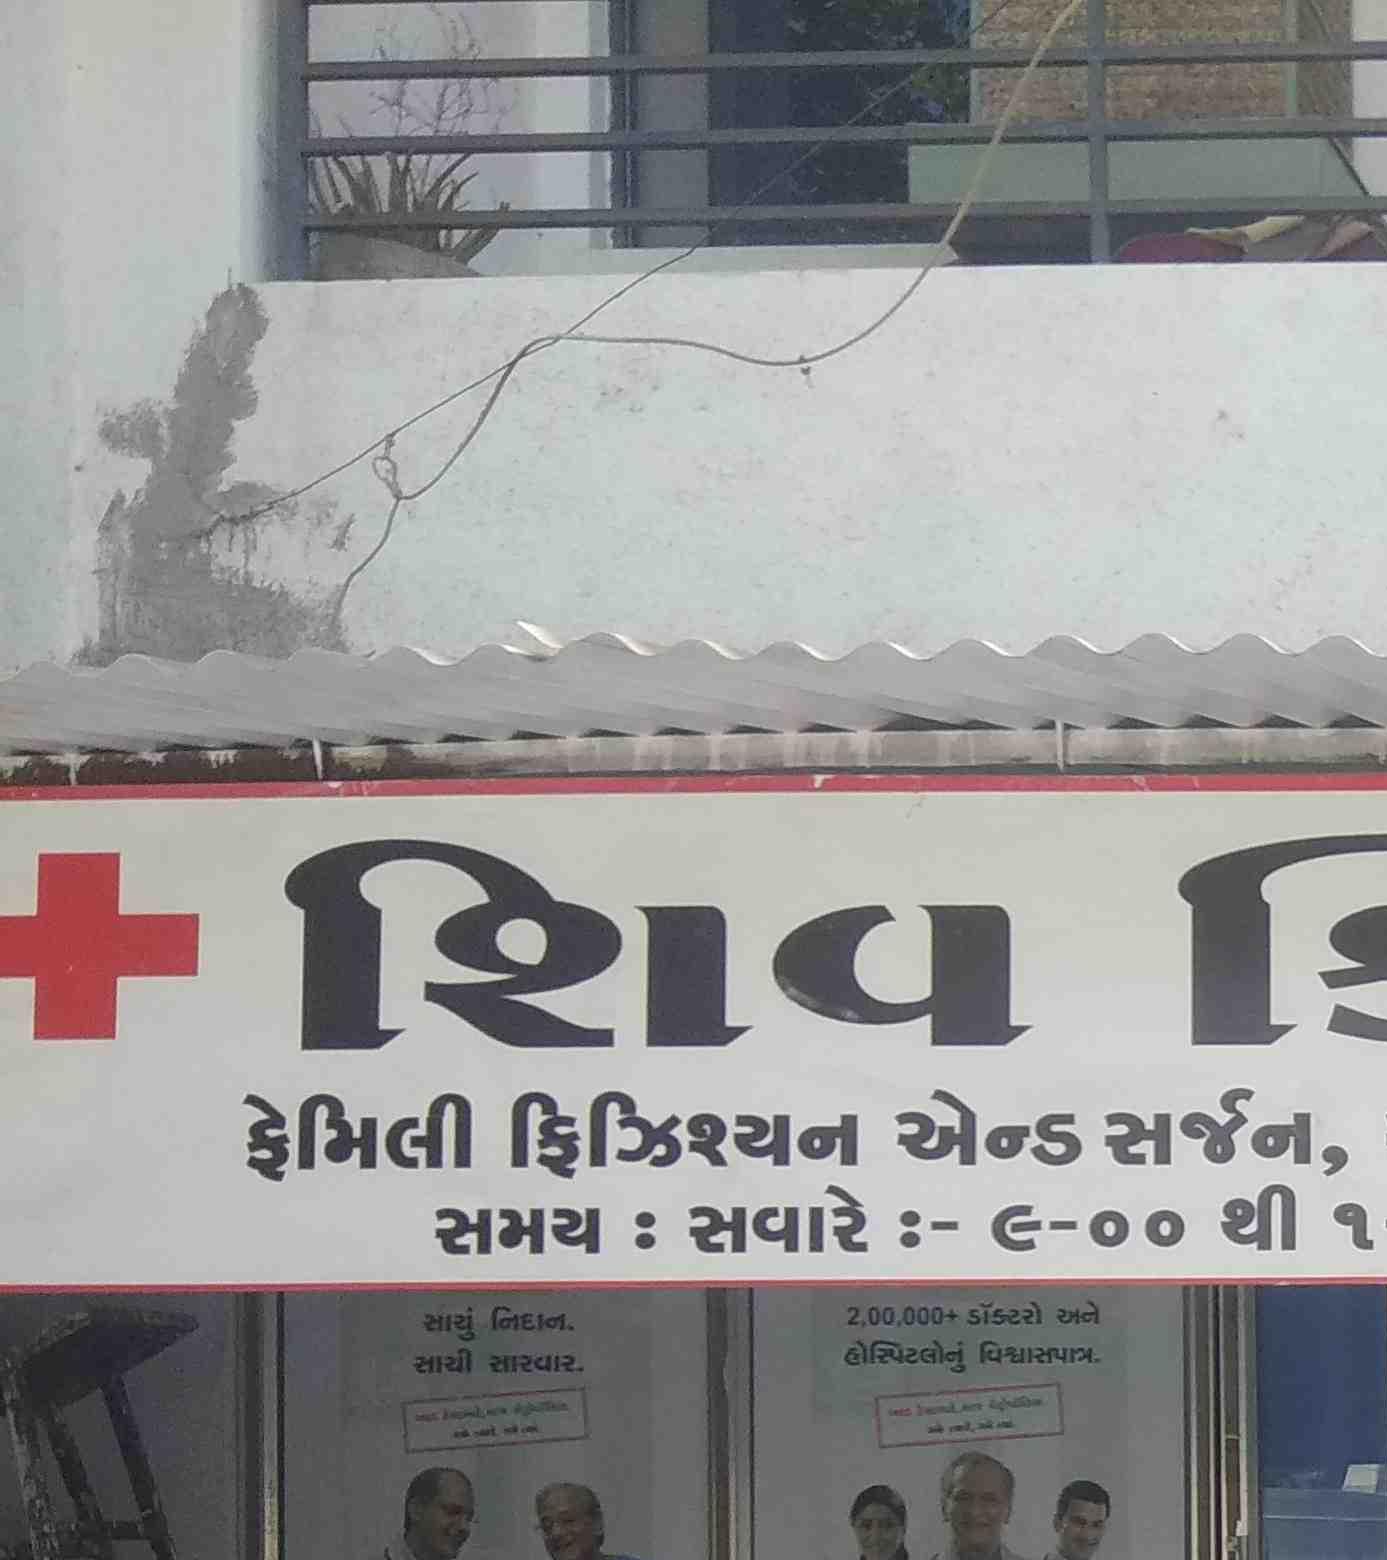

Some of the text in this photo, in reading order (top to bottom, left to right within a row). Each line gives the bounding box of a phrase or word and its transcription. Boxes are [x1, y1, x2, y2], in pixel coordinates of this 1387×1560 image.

[284, 838, 1032, 1051] શિવ
[242, 1092, 472, 1181] ફેમિલી
[895, 1089, 1082, 1166] એન્ડ
[1105, 1087, 1349, 1177] સર્જન,
[434, 1207, 601, 1256] સમય
[689, 1184, 868, 1254] સવારે
[1220, 1184, 1296, 1251] થી
[490, 1306, 575, 1332] નિદાન.
[847, 1306, 957, 1328] 2,00,000+
[1056, 1301, 1100, 1325] અને
[489, 1353, 584, 1374] સારવાર.
